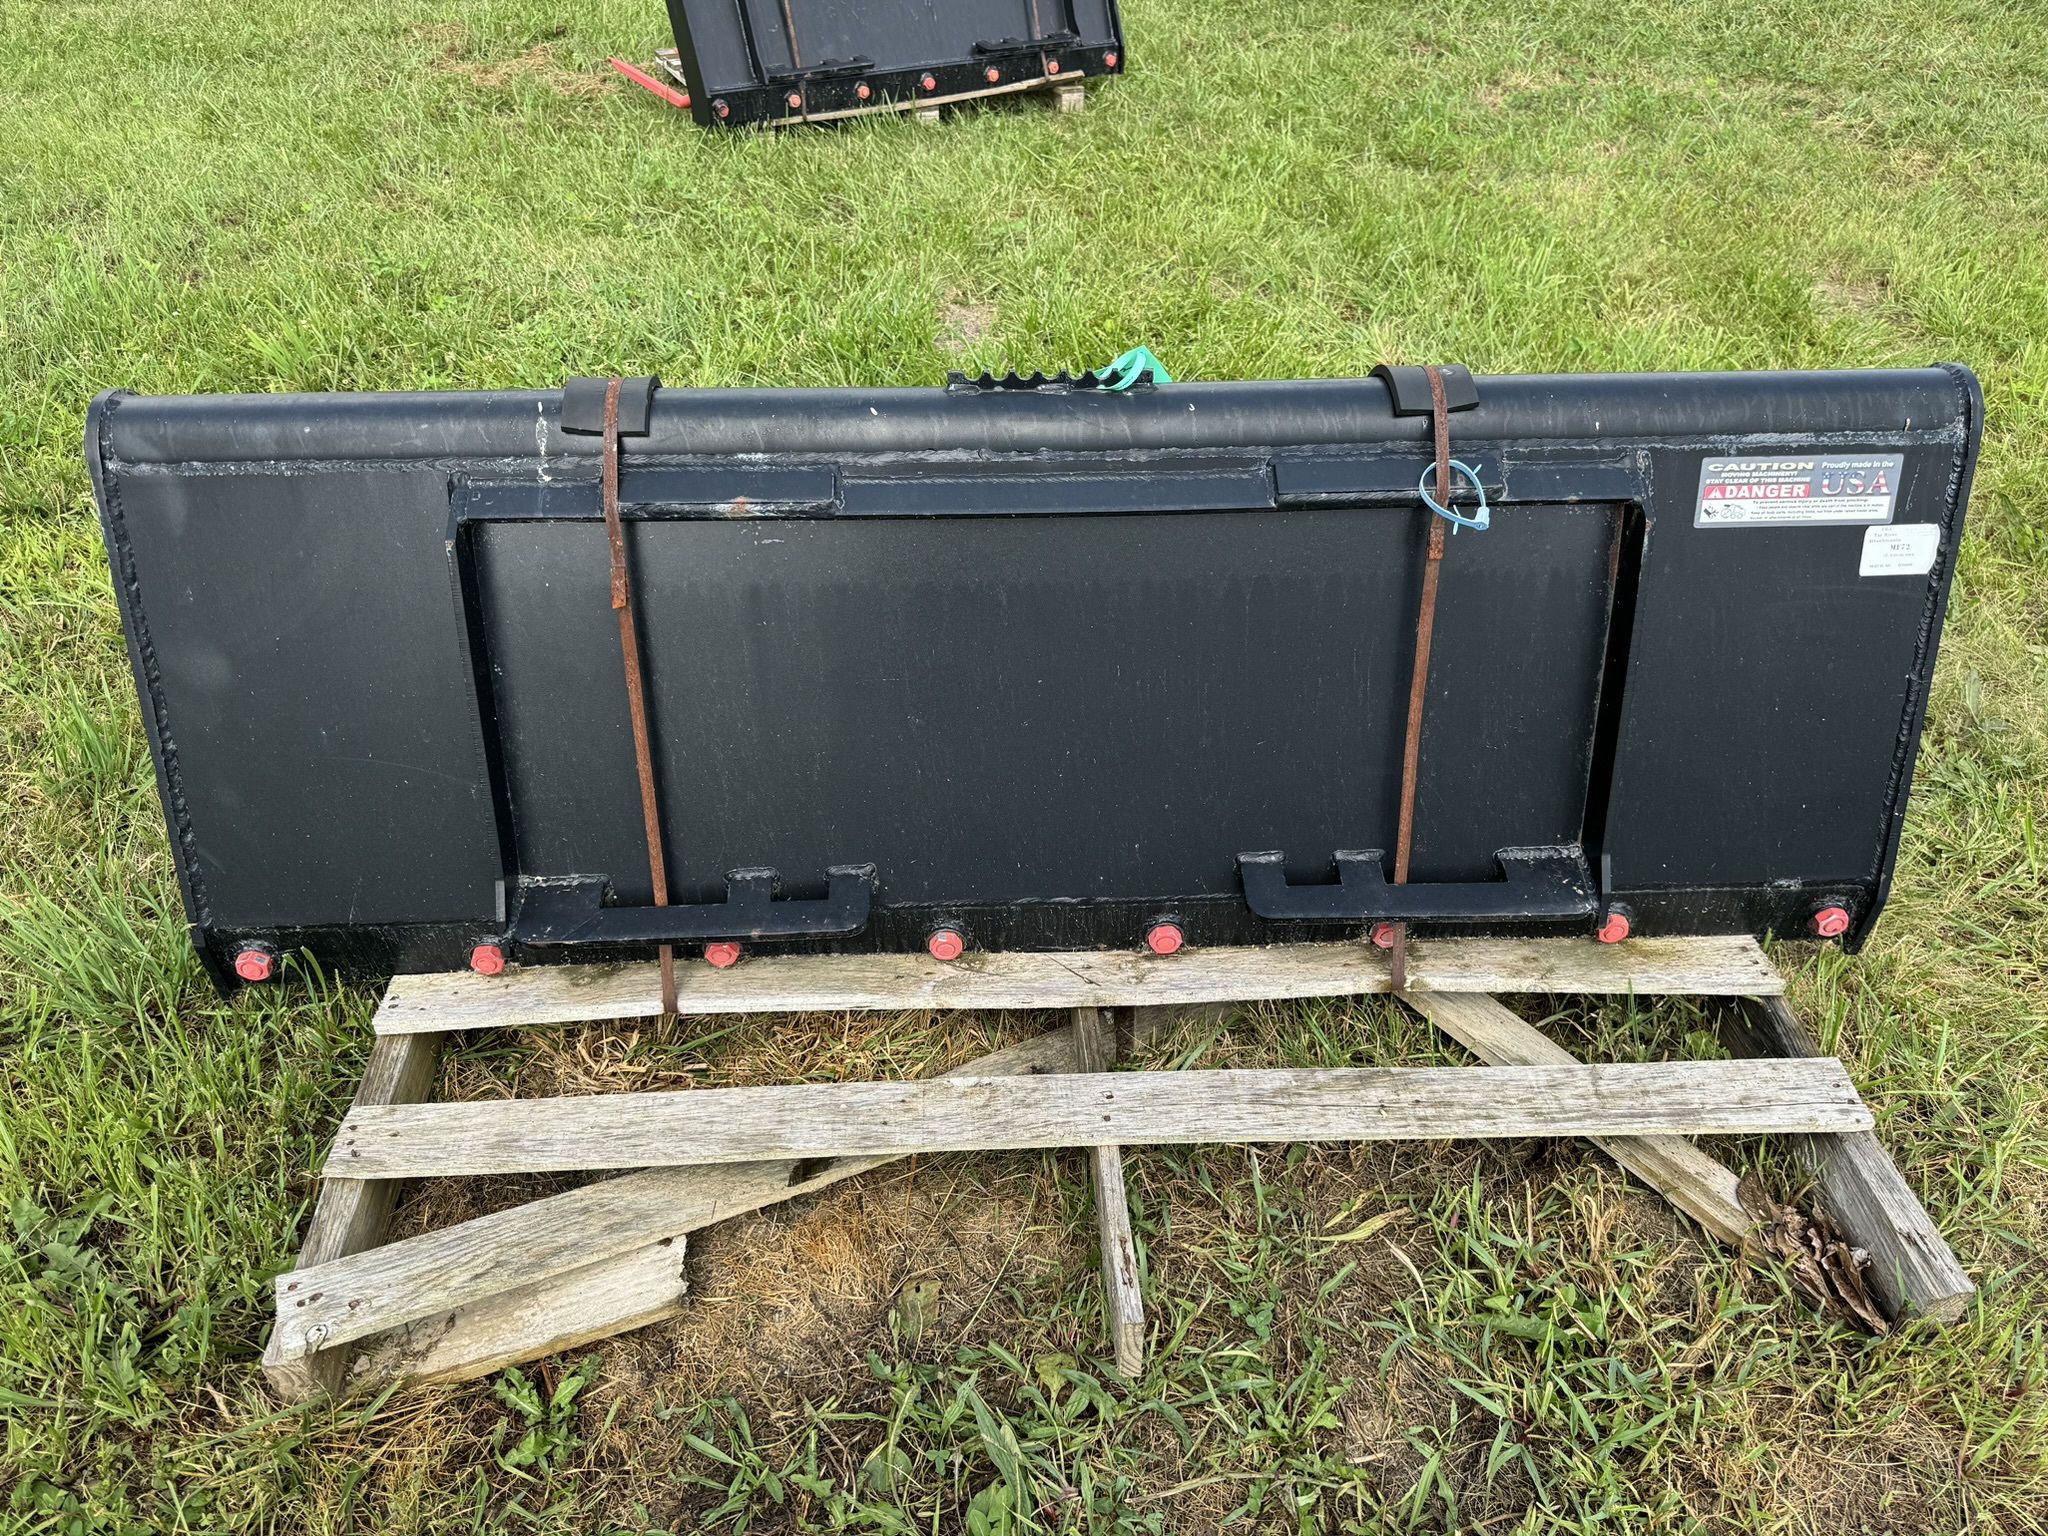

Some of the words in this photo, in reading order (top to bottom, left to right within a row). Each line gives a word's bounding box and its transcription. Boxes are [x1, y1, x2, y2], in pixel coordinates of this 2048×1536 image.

[1708, 462, 1814, 472] CAUTION
[1822, 461, 1851, 470] Proudly
[1822, 470, 1890, 495] USA
[1724, 485, 1806, 499] DANGER
